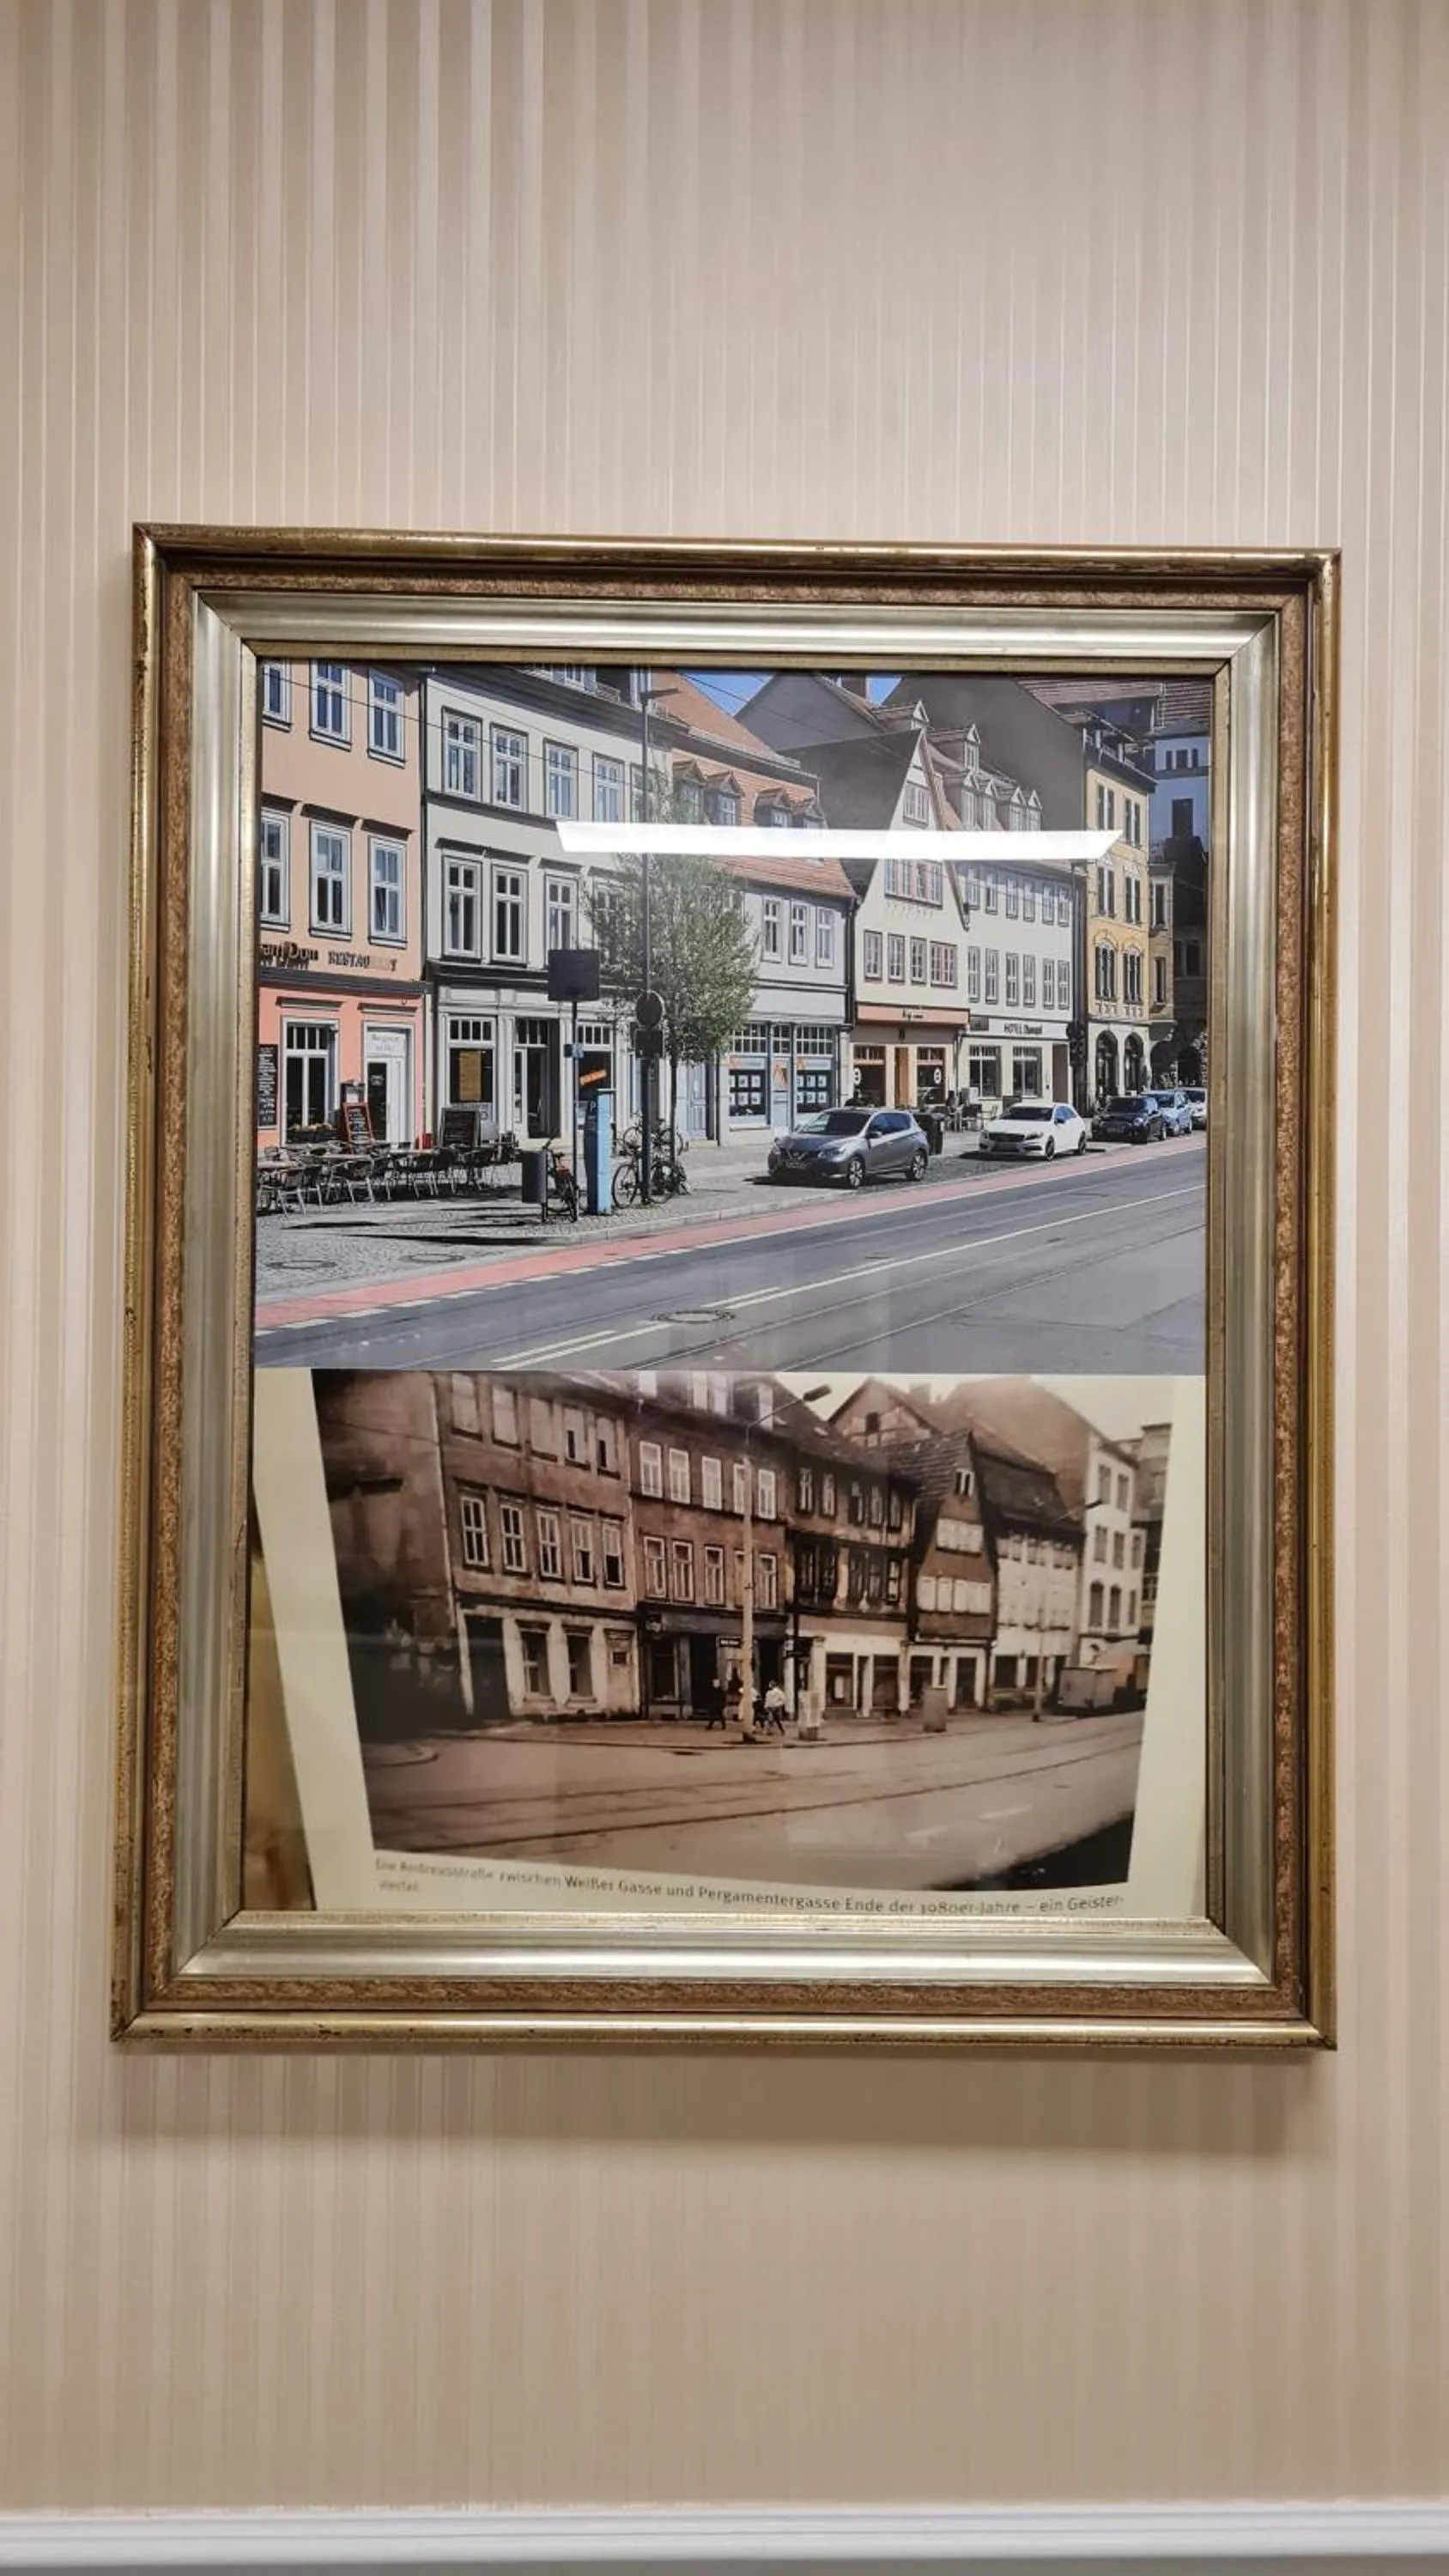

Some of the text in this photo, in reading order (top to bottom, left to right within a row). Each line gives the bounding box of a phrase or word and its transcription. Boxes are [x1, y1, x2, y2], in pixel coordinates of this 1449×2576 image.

[327, 949, 397, 972] RESTAUT
[499, 1871, 561, 1887] zwischen
[564, 1874, 614, 1890] Weißer
[617, 1880, 662, 1896] Gasse
[666, 1883, 694, 1898] und
[698, 1885, 840, 1911] Pergamentergasse
[845, 1896, 884, 1912] Ende
[888, 1899, 913, 1913] der
[1039, 1898, 1064, 1912] ein
